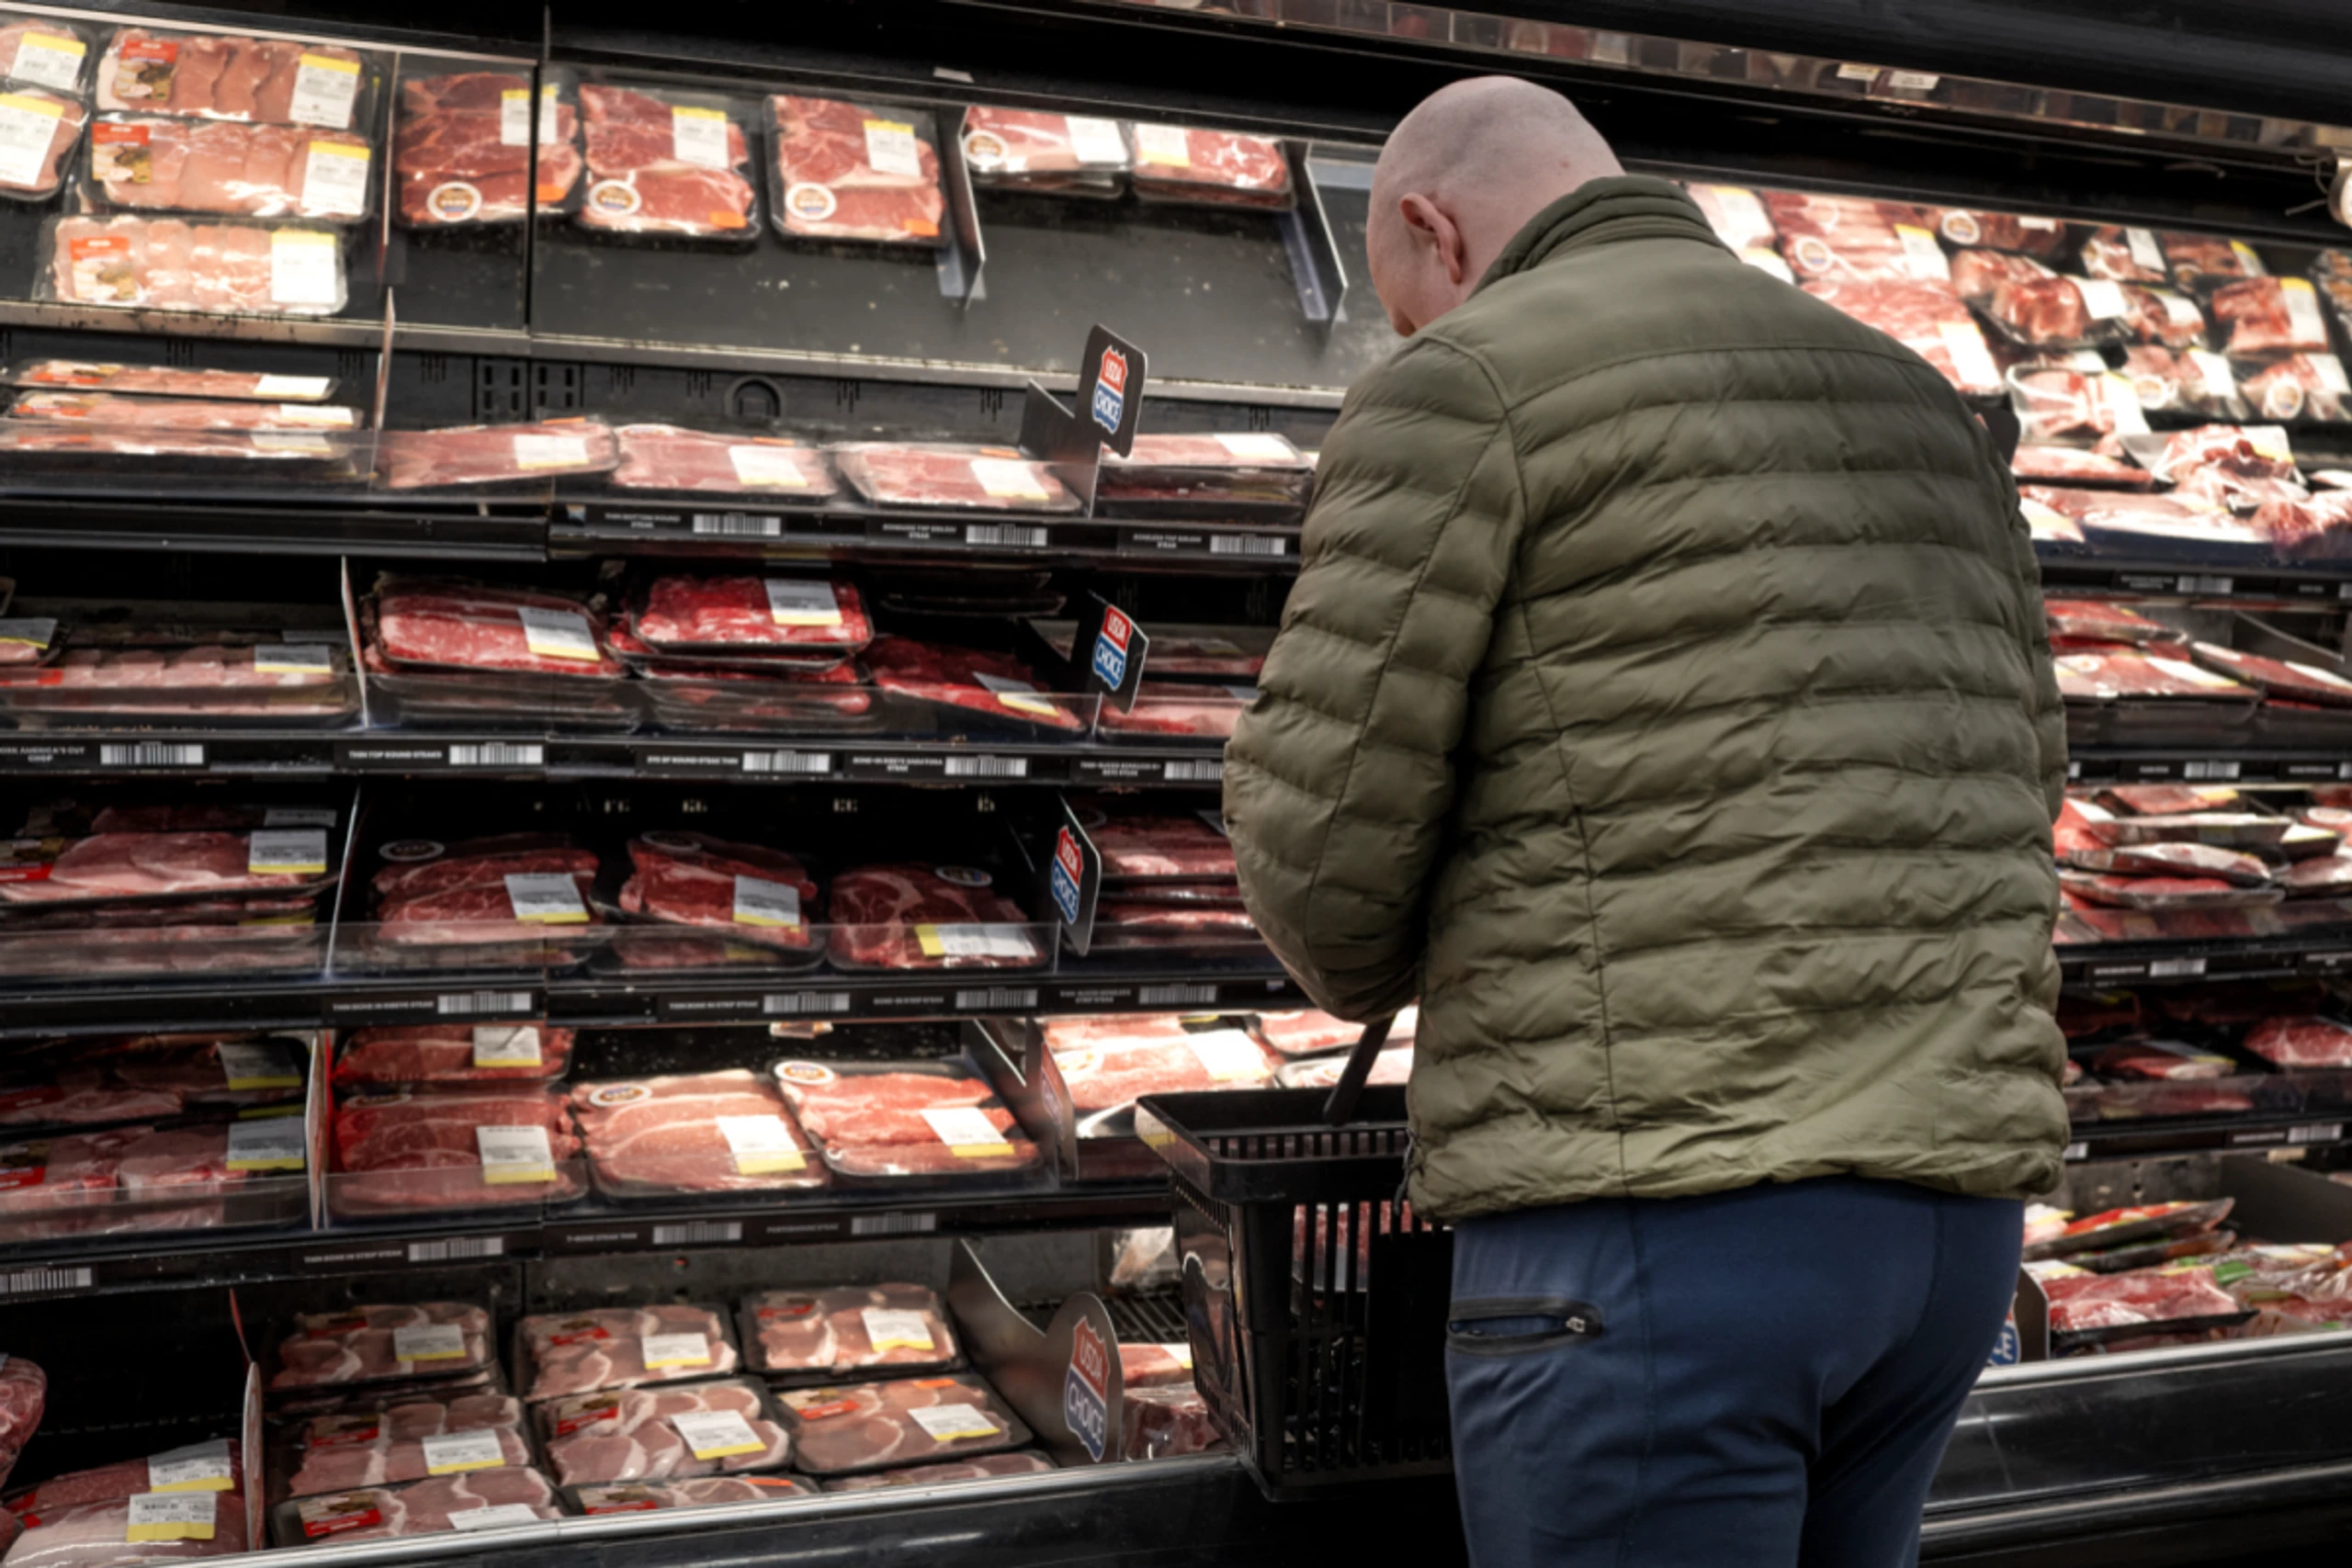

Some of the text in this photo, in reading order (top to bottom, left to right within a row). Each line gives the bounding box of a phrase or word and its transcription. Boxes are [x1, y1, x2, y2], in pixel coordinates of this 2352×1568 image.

[1105, 359, 1122, 387] USDA
[1096, 389, 1120, 423] CHOICE
[1107, 613, 1126, 644] USDA
[1096, 643, 1123, 680] CHOICE
[1061, 839, 1079, 874] USDA
[1053, 866, 1078, 913] CHOICE
[1079, 1335, 1102, 1386] USDA
[1068, 1381, 1104, 1447] CHOICE
